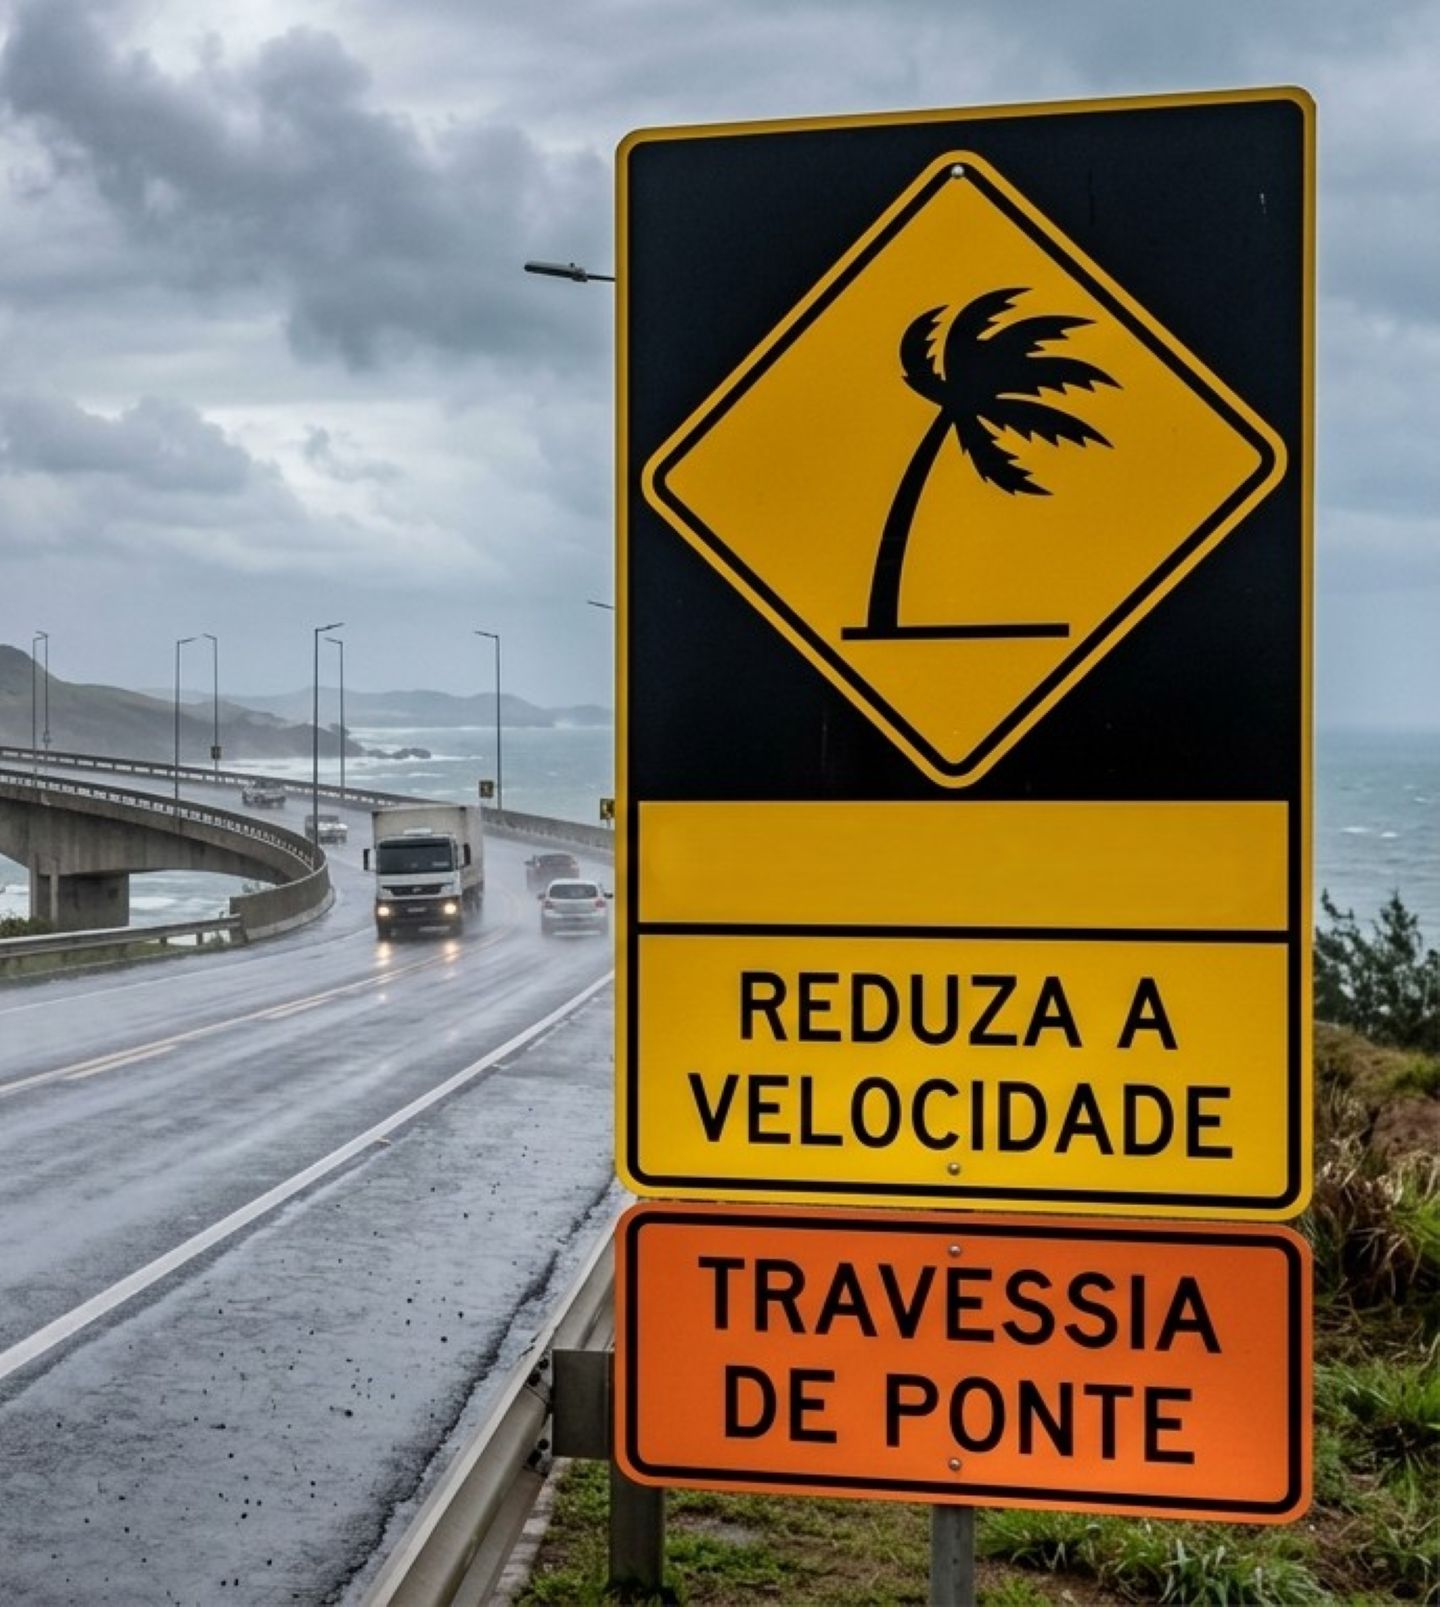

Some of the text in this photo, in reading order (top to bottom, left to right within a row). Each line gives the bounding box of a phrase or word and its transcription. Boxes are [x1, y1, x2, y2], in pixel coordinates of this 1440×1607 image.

[740, 971, 1178, 1050] REDUZA A
[687, 1072, 1233, 1159] VELOCIDADE
[698, 1256, 1222, 1354] TRAVESSIA
[724, 1365, 1195, 1465] DE PONTE
